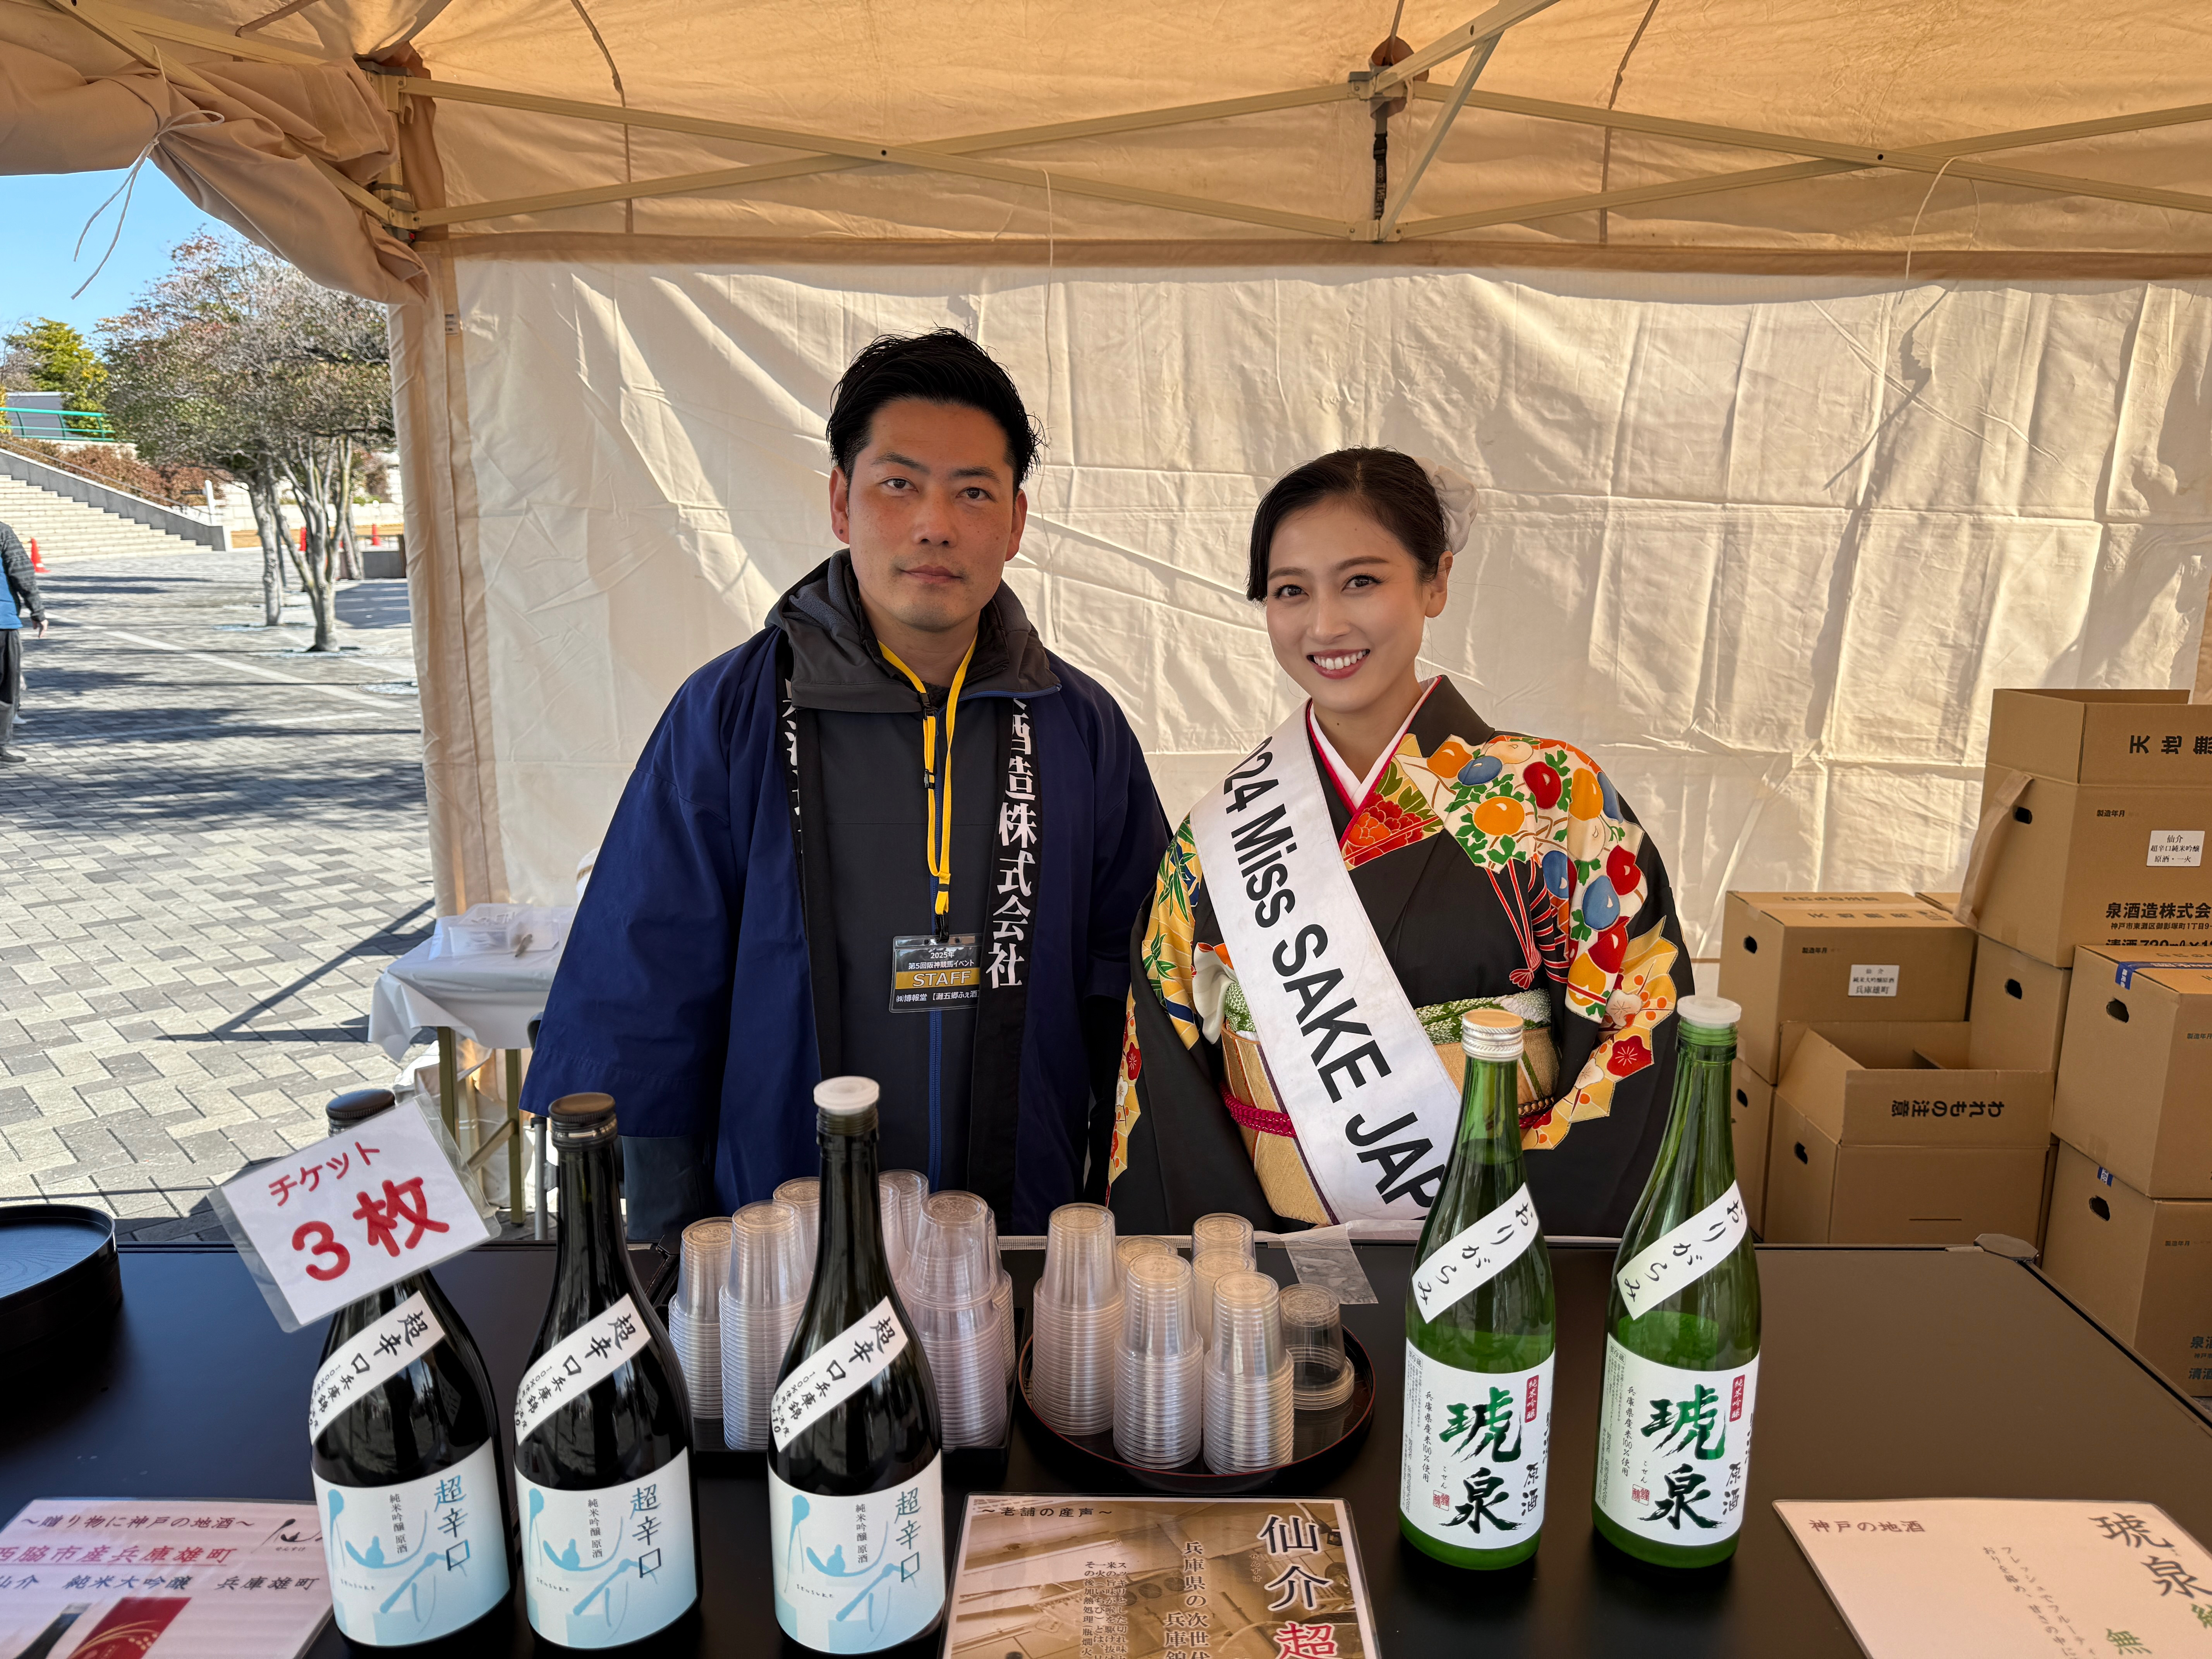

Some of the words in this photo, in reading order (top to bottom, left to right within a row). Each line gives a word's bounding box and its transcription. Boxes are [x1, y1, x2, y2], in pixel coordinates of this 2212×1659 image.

[986, 698, 1037, 989] 酒造株式会社
[2167, 835, 2183, 843] 仙介
[912, 970, 971, 987] STAFF
[1231, 803, 1298, 928] Miss
[1273, 924, 1392, 1103] SAKE
[1345, 1111, 1445, 1220] JAP
[1891, 1100, 2005, 1118] われもの注意
[268, 1141, 380, 1207] チケット
[291, 1176, 450, 1281] 3枚
[1418, 1201, 1534, 1306] おりがらみ
[1624, 1199, 1743, 1303] おりがらみ
[350, 1310, 428, 1375] 超辛口
[562, 1312, 636, 1376] 超辛口
[826, 1316, 896, 1381] 超辛口
[1422, 1391, 1434, 1483] 兵庫県産米100%使用
[1621, 1386, 1636, 1477] 兵庫県産米100%使用
[1521, 1462, 1539, 1516] 原酒
[1723, 1462, 1741, 1515] 原酒
[434, 1474, 471, 1572] 超辛口
[629, 1483, 663, 1579] 超辛口
[894, 1487, 922, 1583] 超辛口
[1808, 1519, 1926, 1534] 神戸の地酒
[62, 1574, 194, 1590] 純米大吟醸
[217, 1577, 320, 1590] 兵庫雄町
[1250, 1554, 1262, 1582] せんすけ
[1259, 1515, 1331, 1609] 仙介
